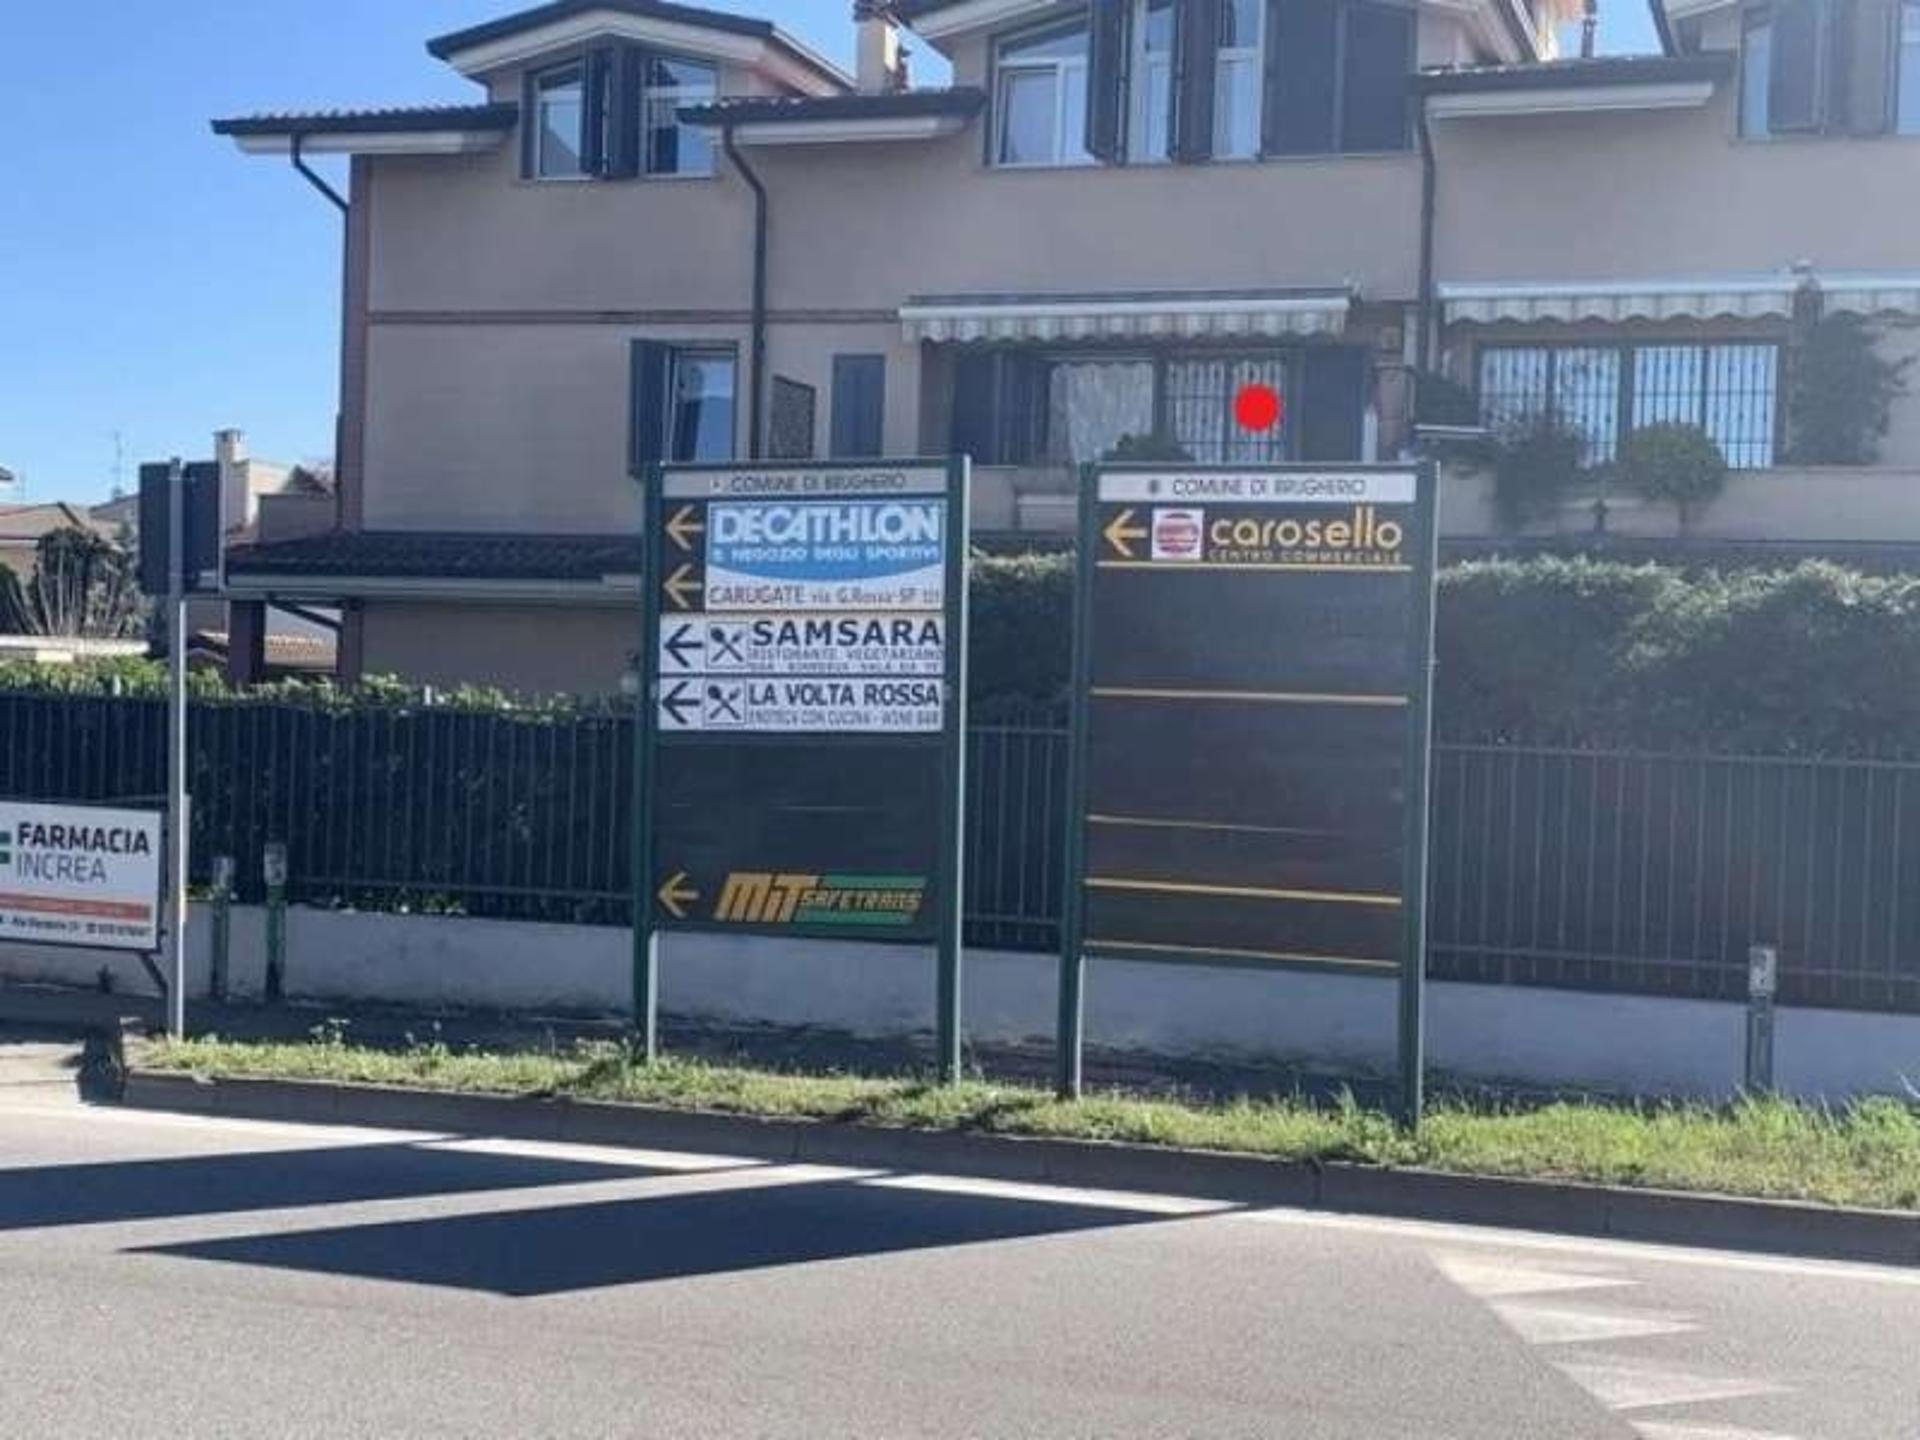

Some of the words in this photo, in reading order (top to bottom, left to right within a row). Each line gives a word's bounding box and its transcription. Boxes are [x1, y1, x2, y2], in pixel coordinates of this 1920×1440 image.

[731, 476, 796, 493] COMUNE
[803, 475, 818, 490] DI
[825, 473, 906, 490] BRUGHERIO
[1172, 479, 1243, 496] COMUNE
[1250, 479, 1266, 495] DI
[1274, 478, 1366, 495] BRUGHERIO
[714, 506, 939, 543] DECATHLON
[1210, 503, 1403, 549] carosello
[1209, 551, 1272, 563] CENTRO
[1279, 551, 1402, 564] COMMERCIALE
[709, 585, 805, 604] CARUGATE
[752, 619, 940, 647] SAMSARA
[749, 684, 776, 706] LA
[785, 684, 855, 706] VOLTA
[864, 684, 940, 706] ROSSA
[17, 822, 150, 853] FARMACIA
[17, 852, 108, 884] INCREA
